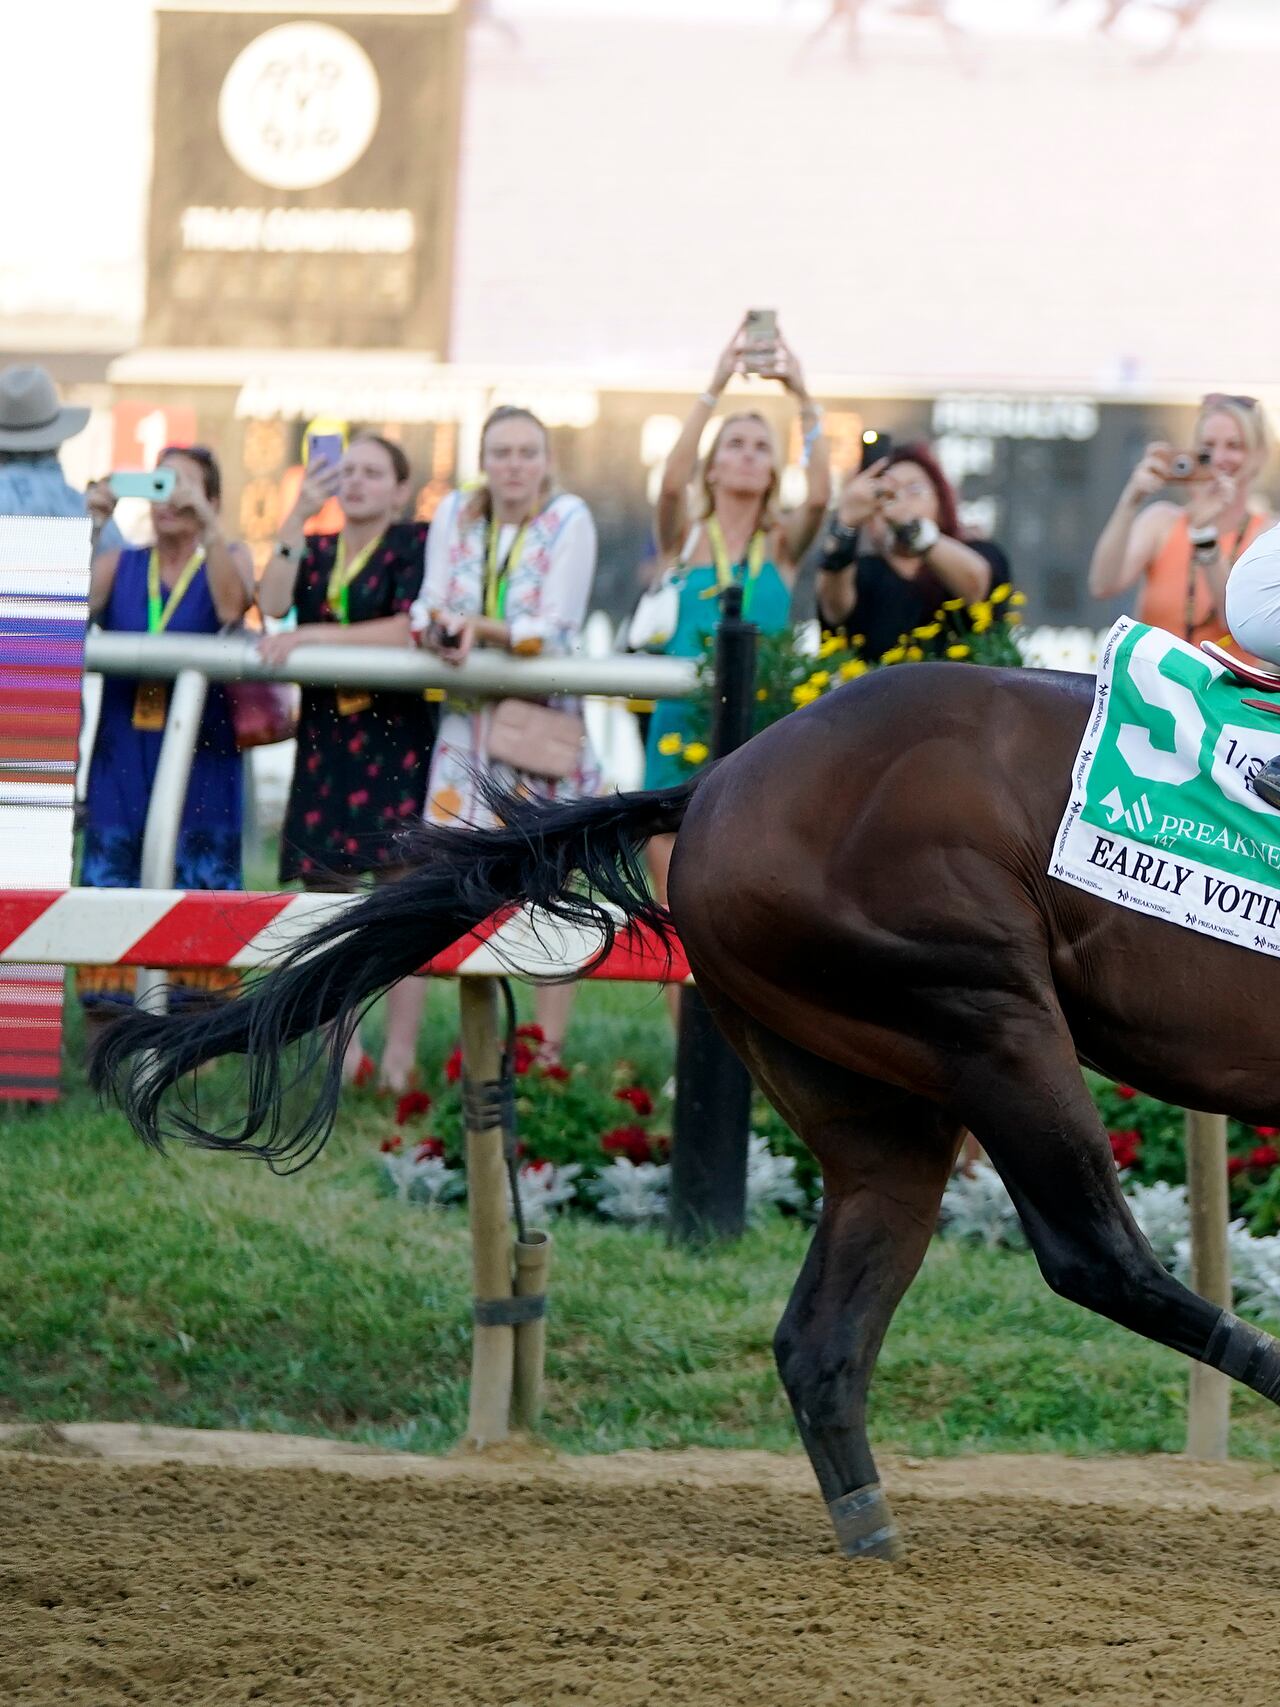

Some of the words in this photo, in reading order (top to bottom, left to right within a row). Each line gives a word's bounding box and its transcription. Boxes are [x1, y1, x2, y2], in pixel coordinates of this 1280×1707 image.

[181, 207, 262, 252] TRACK
[263, 207, 414, 253] CONDITIONS
[1116, 624, 1227, 786] 5
[1152, 833, 1177, 848] 147
[1087, 836, 1194, 896] EARLY
[1065, 871, 1098, 889] PREAKNESS
[1129, 896, 1166, 913] PREAKNESS
[1197, 919, 1235, 937] PREAKNESS
